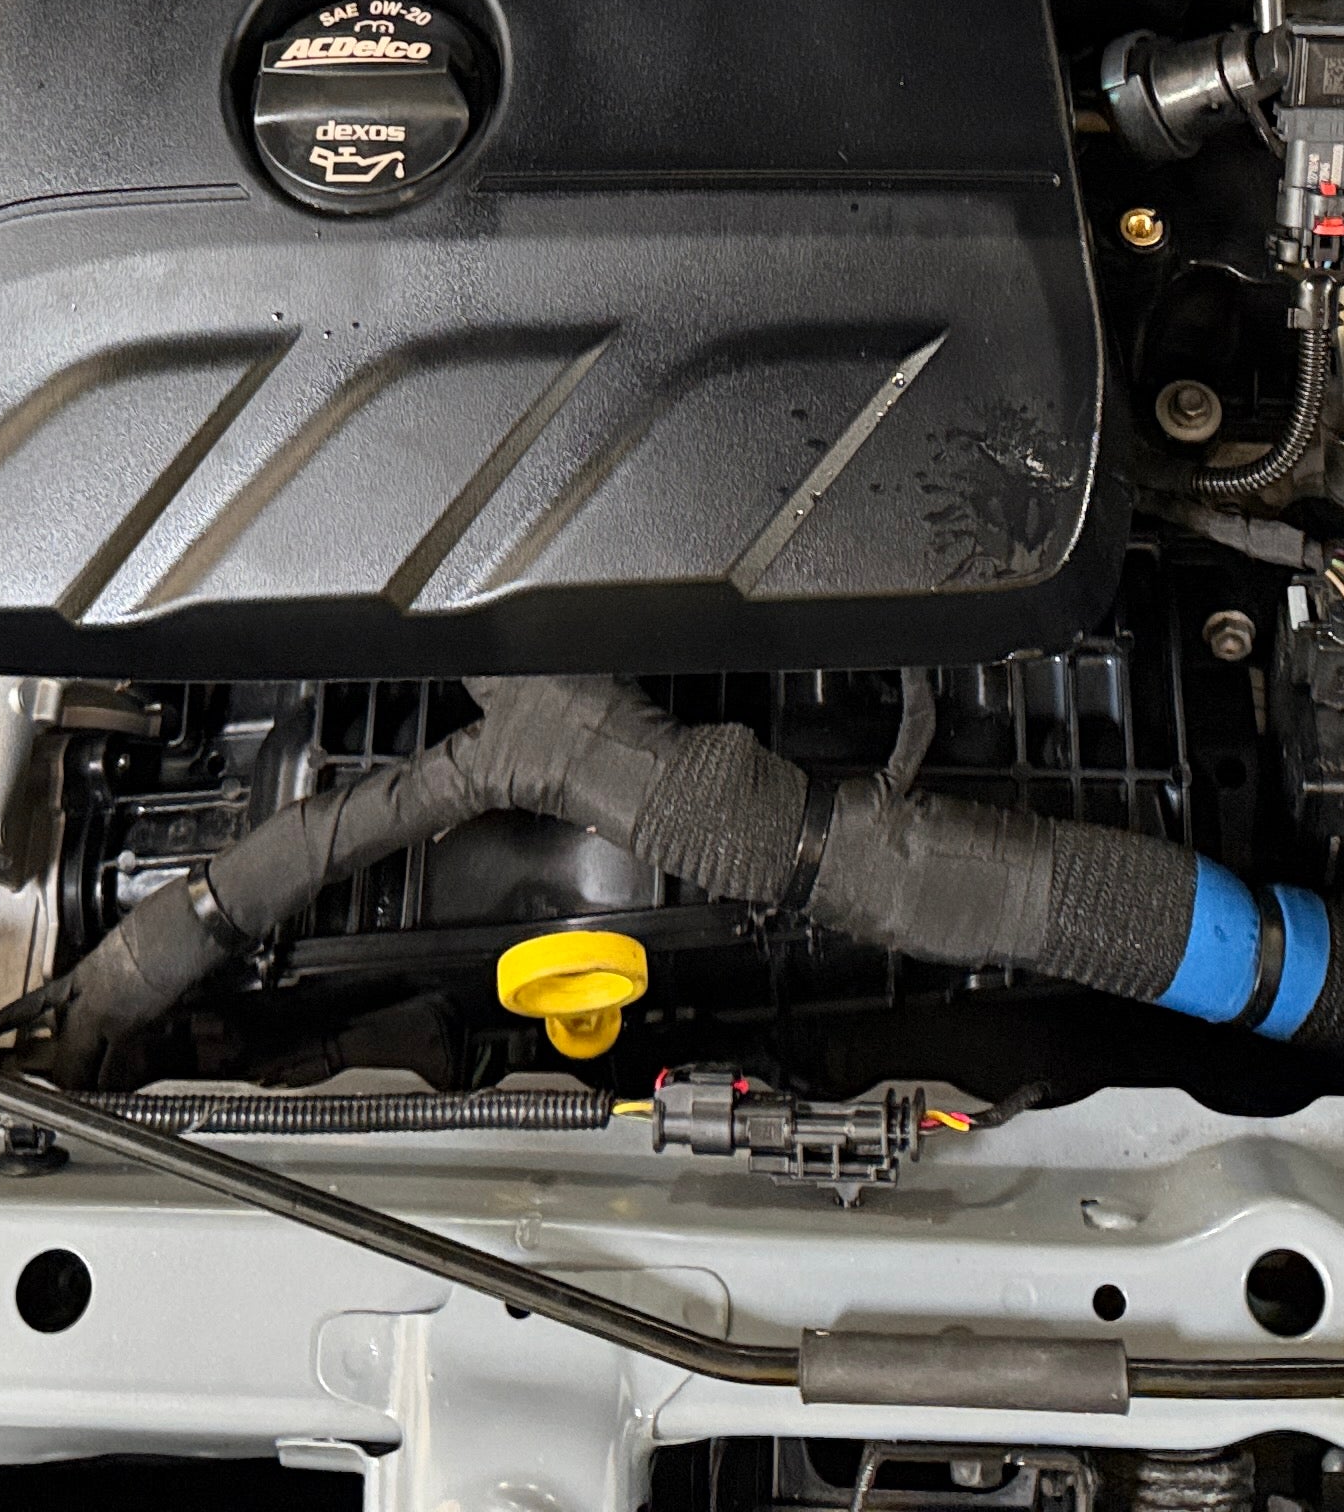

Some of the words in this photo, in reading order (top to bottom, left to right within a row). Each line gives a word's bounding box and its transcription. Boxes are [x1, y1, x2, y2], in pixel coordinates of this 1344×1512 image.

[319, 2, 360, 28] SAE
[369, 0, 432, 27] 0W-20
[279, 36, 432, 62] ACDelco
[316, 120, 407, 142] dexos
